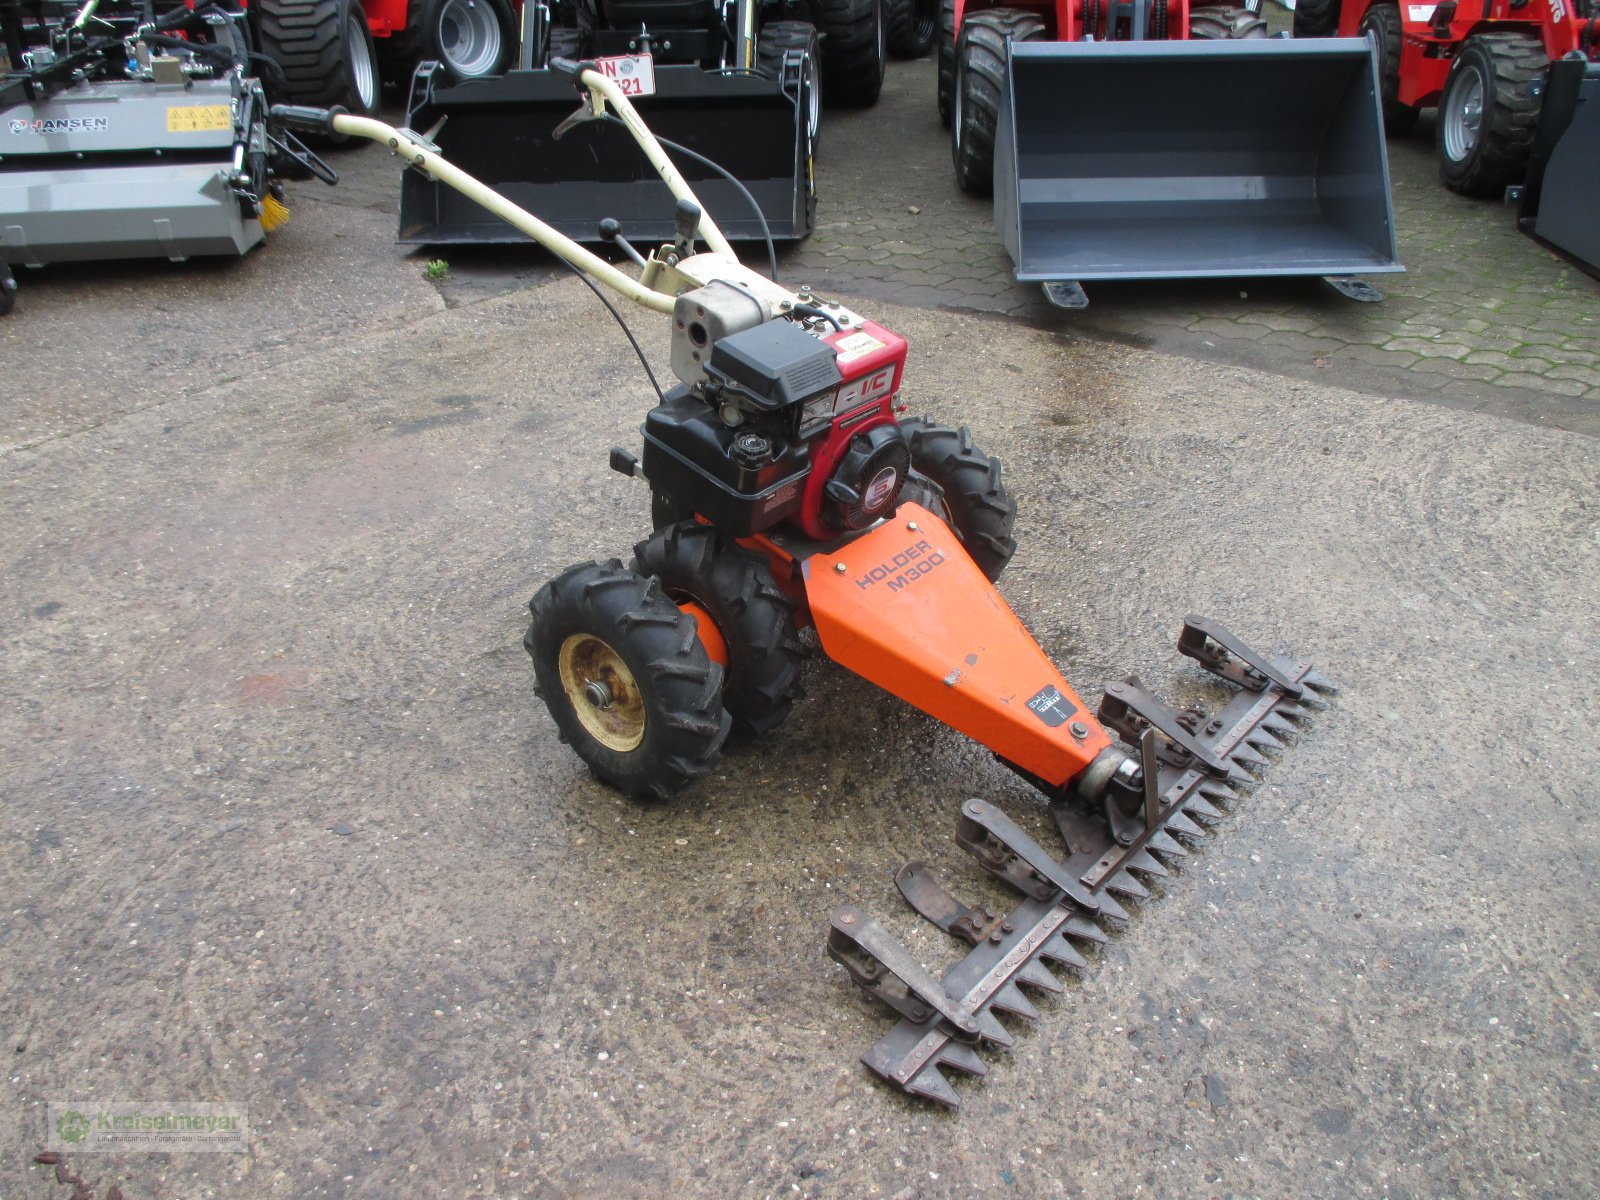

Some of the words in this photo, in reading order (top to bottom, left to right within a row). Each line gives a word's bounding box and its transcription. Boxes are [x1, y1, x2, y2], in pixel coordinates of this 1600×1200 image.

[31, 117, 107, 129] JANSEN
[861, 371, 887, 396] I/C
[855, 540, 932, 590] HOLDER
[886, 552, 945, 593] M300
